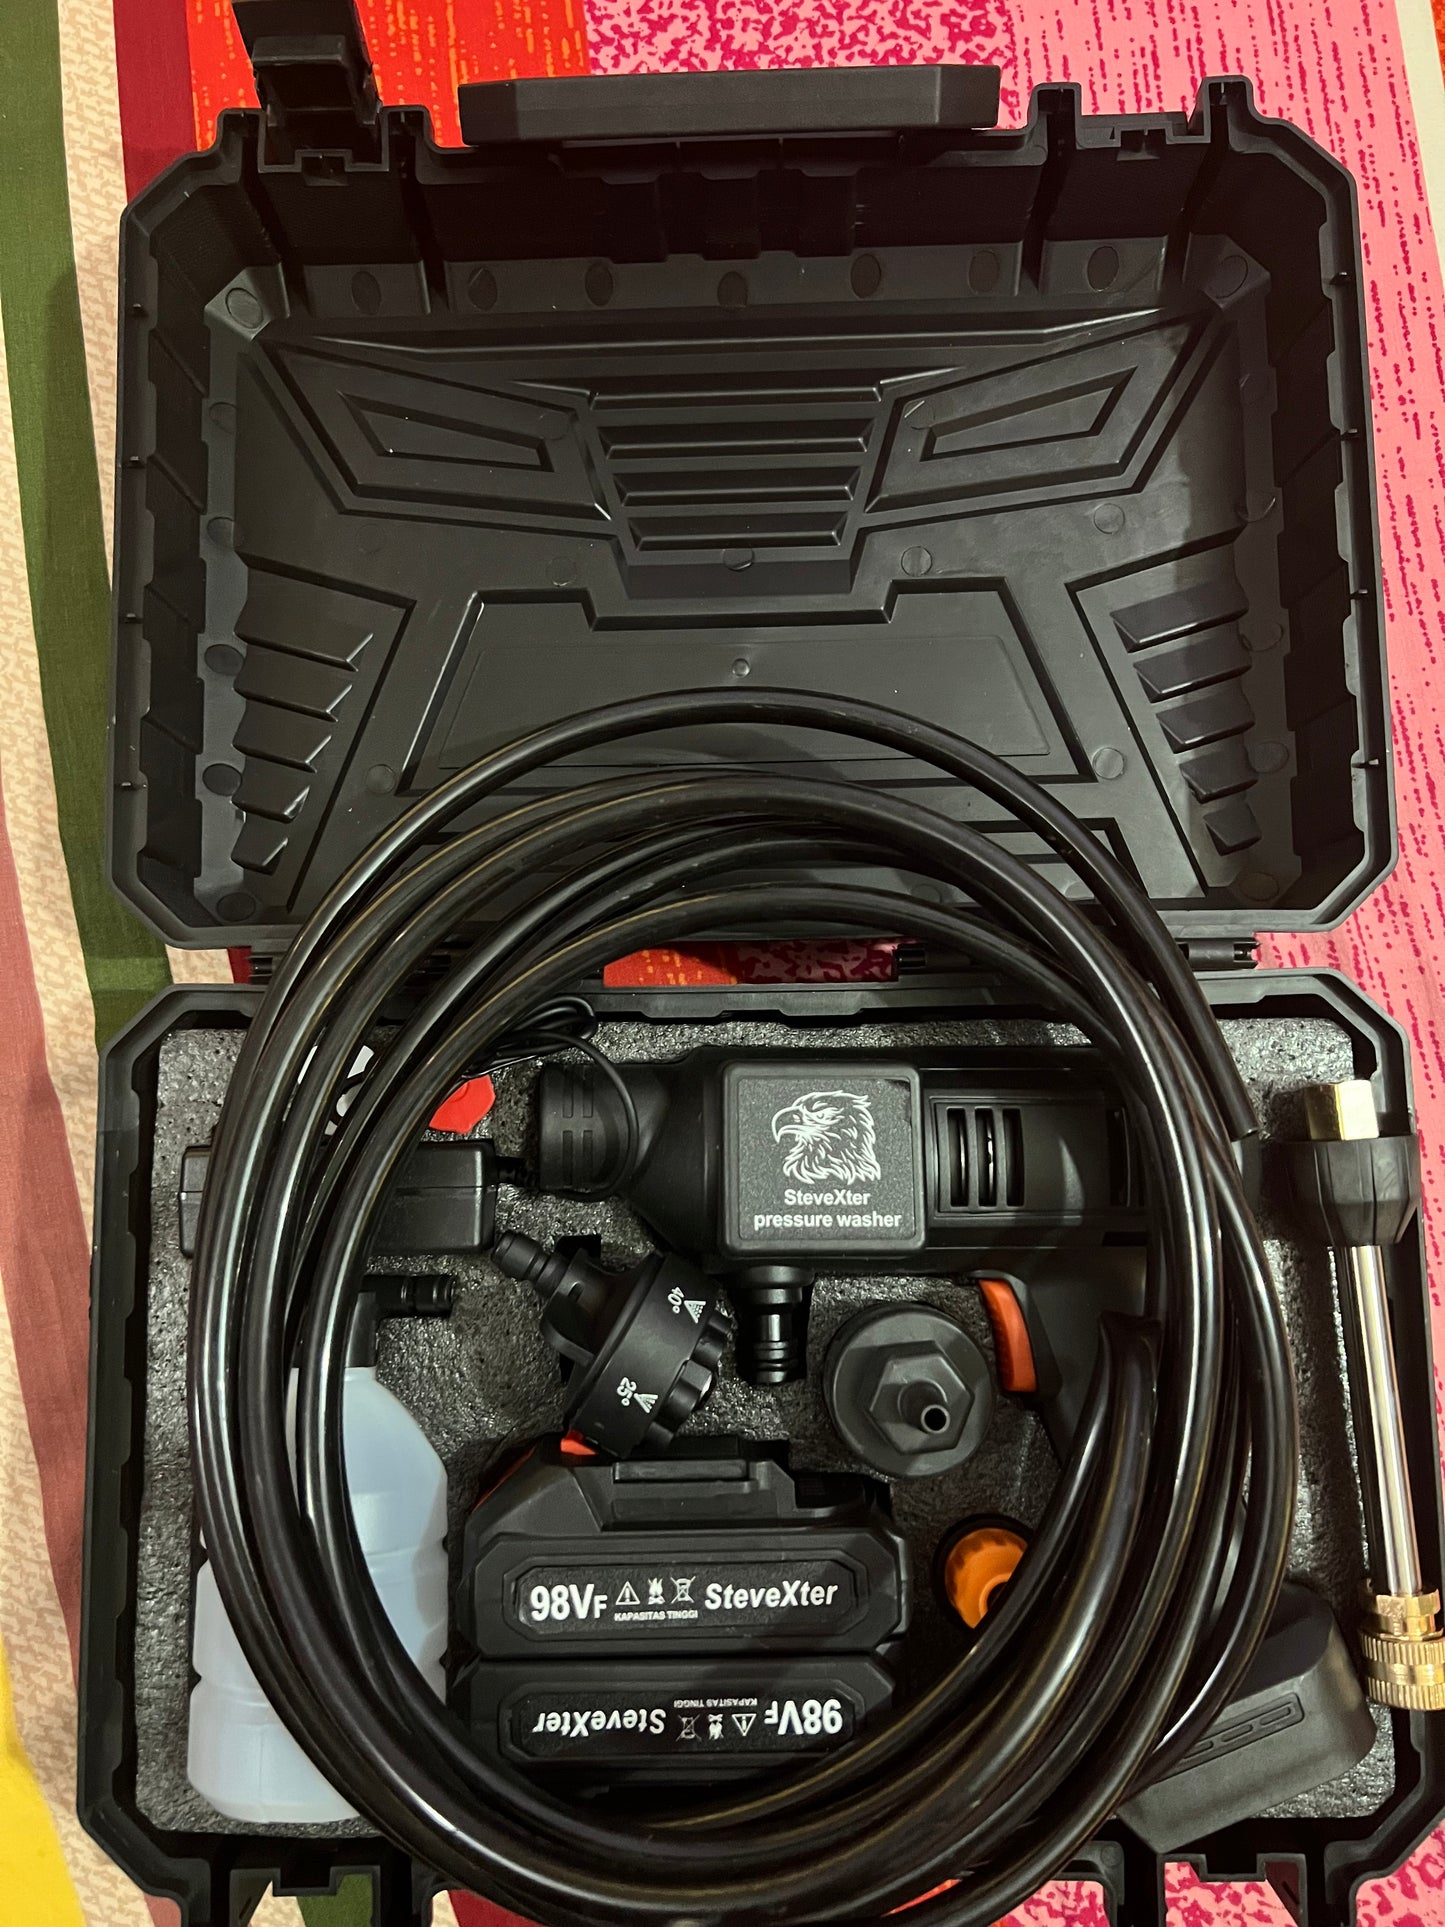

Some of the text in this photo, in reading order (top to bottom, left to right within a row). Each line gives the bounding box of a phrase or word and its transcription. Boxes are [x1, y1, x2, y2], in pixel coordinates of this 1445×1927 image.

[784, 1188, 870, 1206] SteveXter
[754, 1210, 902, 1231] pressure washer
[704, 1580, 839, 1610] SteveXter
[532, 1708, 667, 1738] SteveXter
